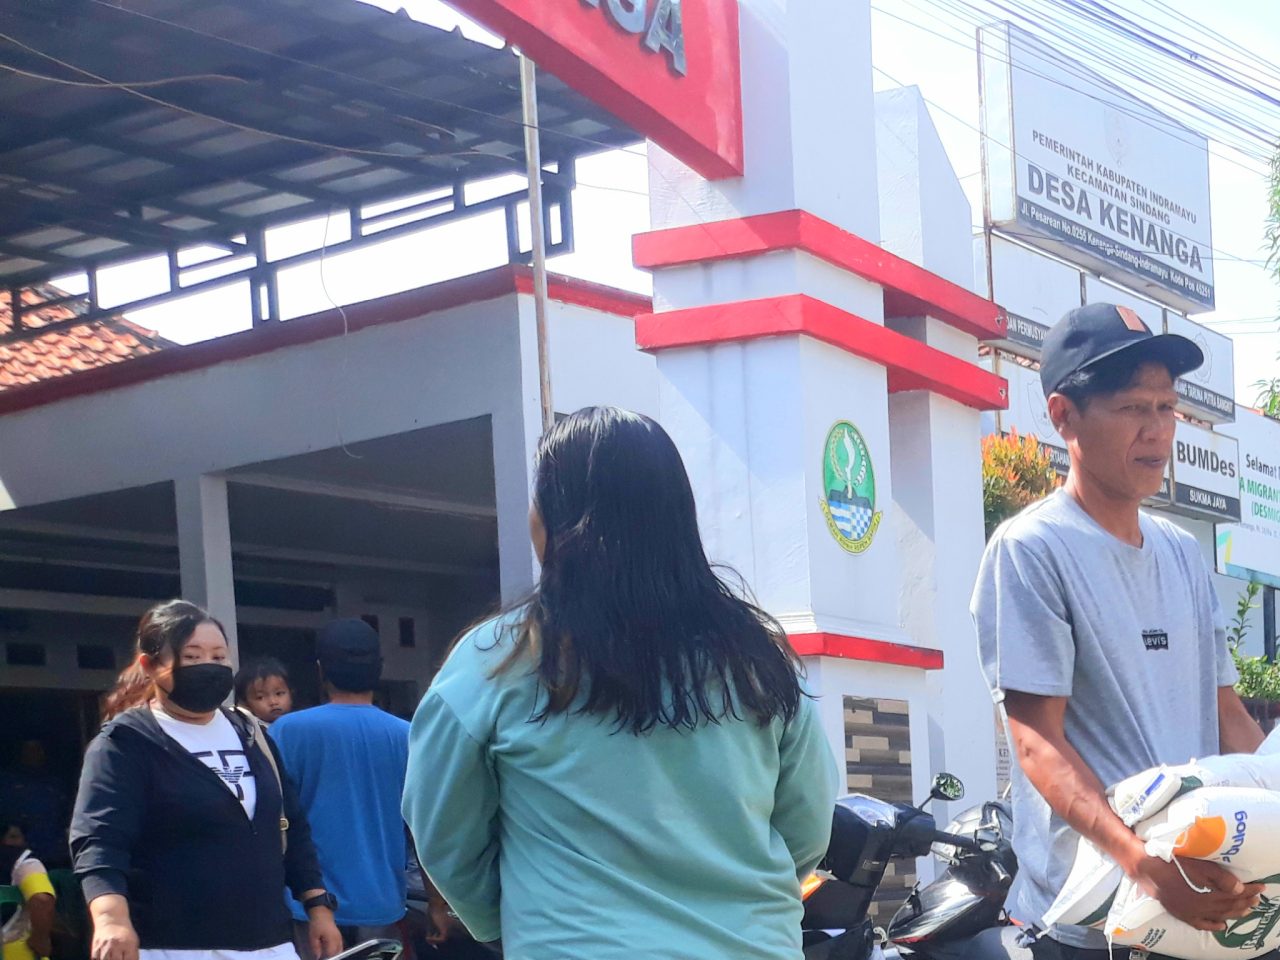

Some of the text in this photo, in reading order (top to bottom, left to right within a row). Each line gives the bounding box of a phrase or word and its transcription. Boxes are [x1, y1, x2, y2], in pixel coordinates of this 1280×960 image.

[1032, 129, 1197, 224] PEMERINTAH KABUPATEN INDRAMAYU
[1067, 163, 1171, 225] KECAMATAN SINDANG
[1027, 163, 1203, 273] DESA KENANGA
[1176, 440, 1236, 478] BUMDes
[1245, 453, 1277, 479] Selamat
[1220, 810, 1248, 856] bulog
